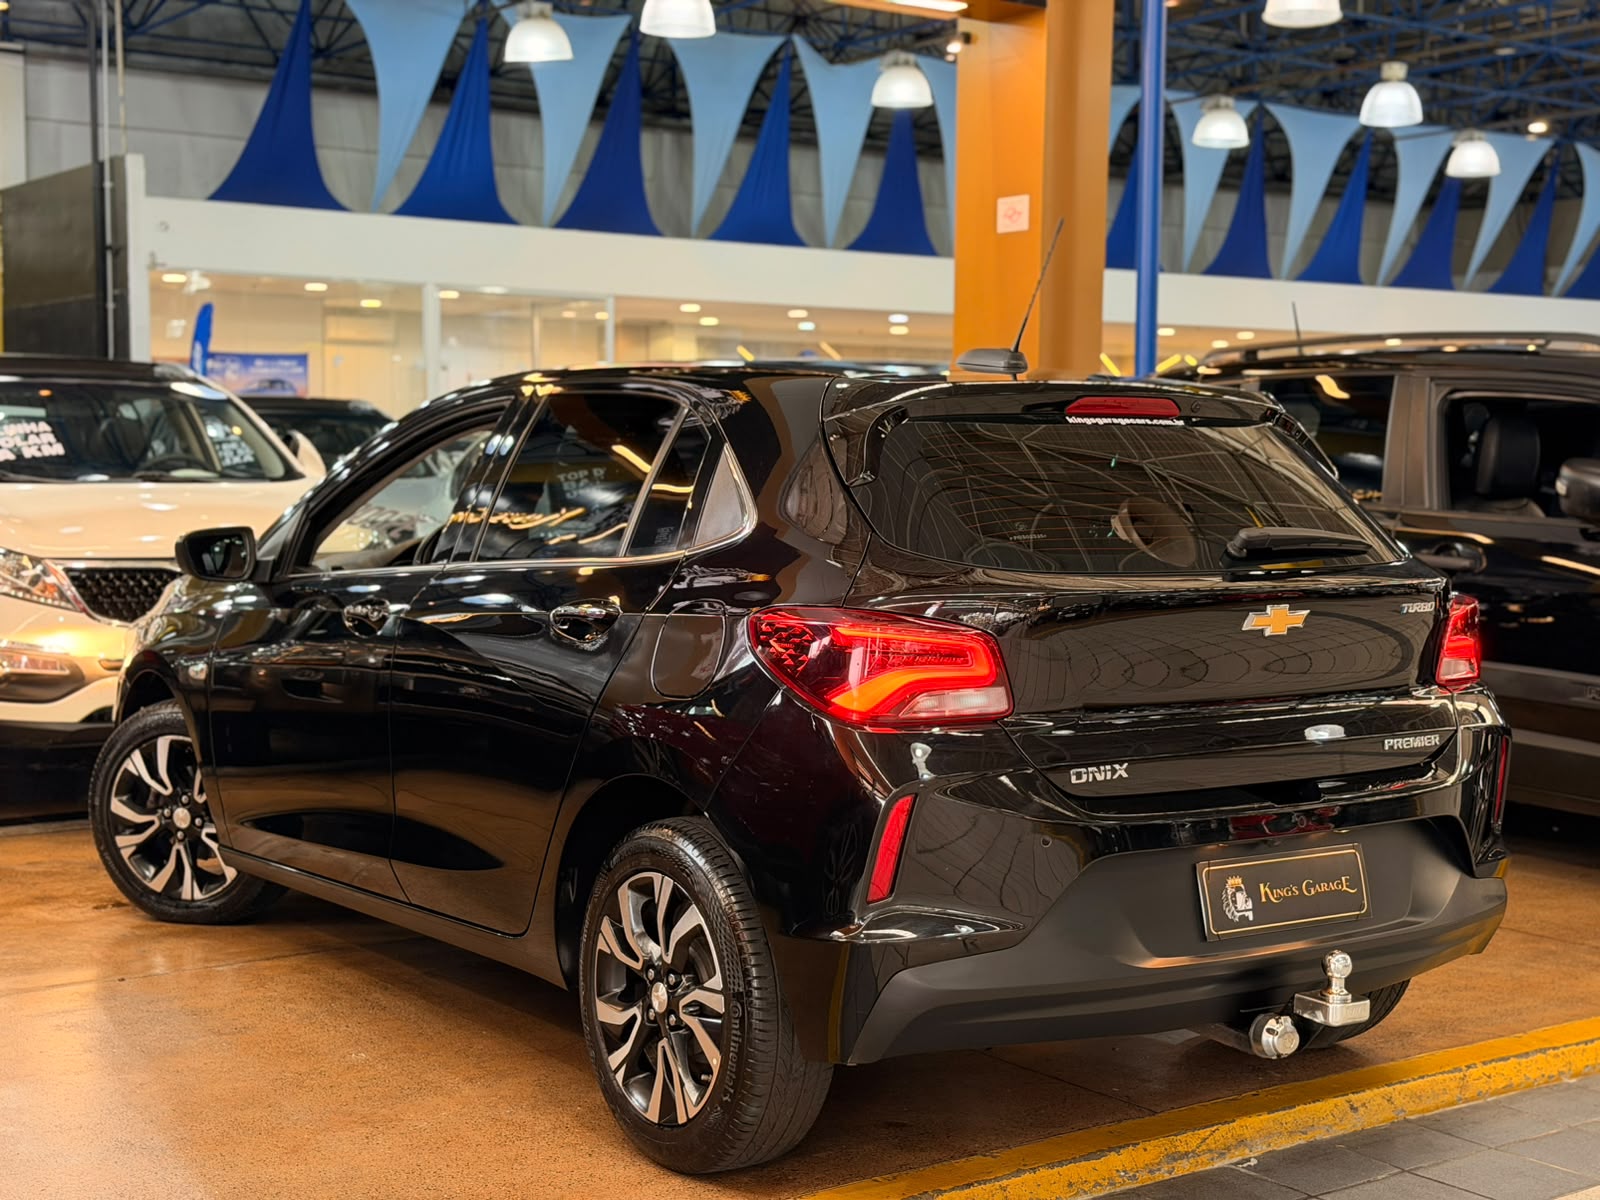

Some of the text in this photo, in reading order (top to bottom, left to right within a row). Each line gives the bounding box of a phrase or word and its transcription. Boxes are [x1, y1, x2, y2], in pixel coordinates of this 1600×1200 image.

[1400, 601, 1436, 614] TURBO
[1383, 734, 1440, 750] PREMIER
[1070, 762, 1129, 784] ONIX
